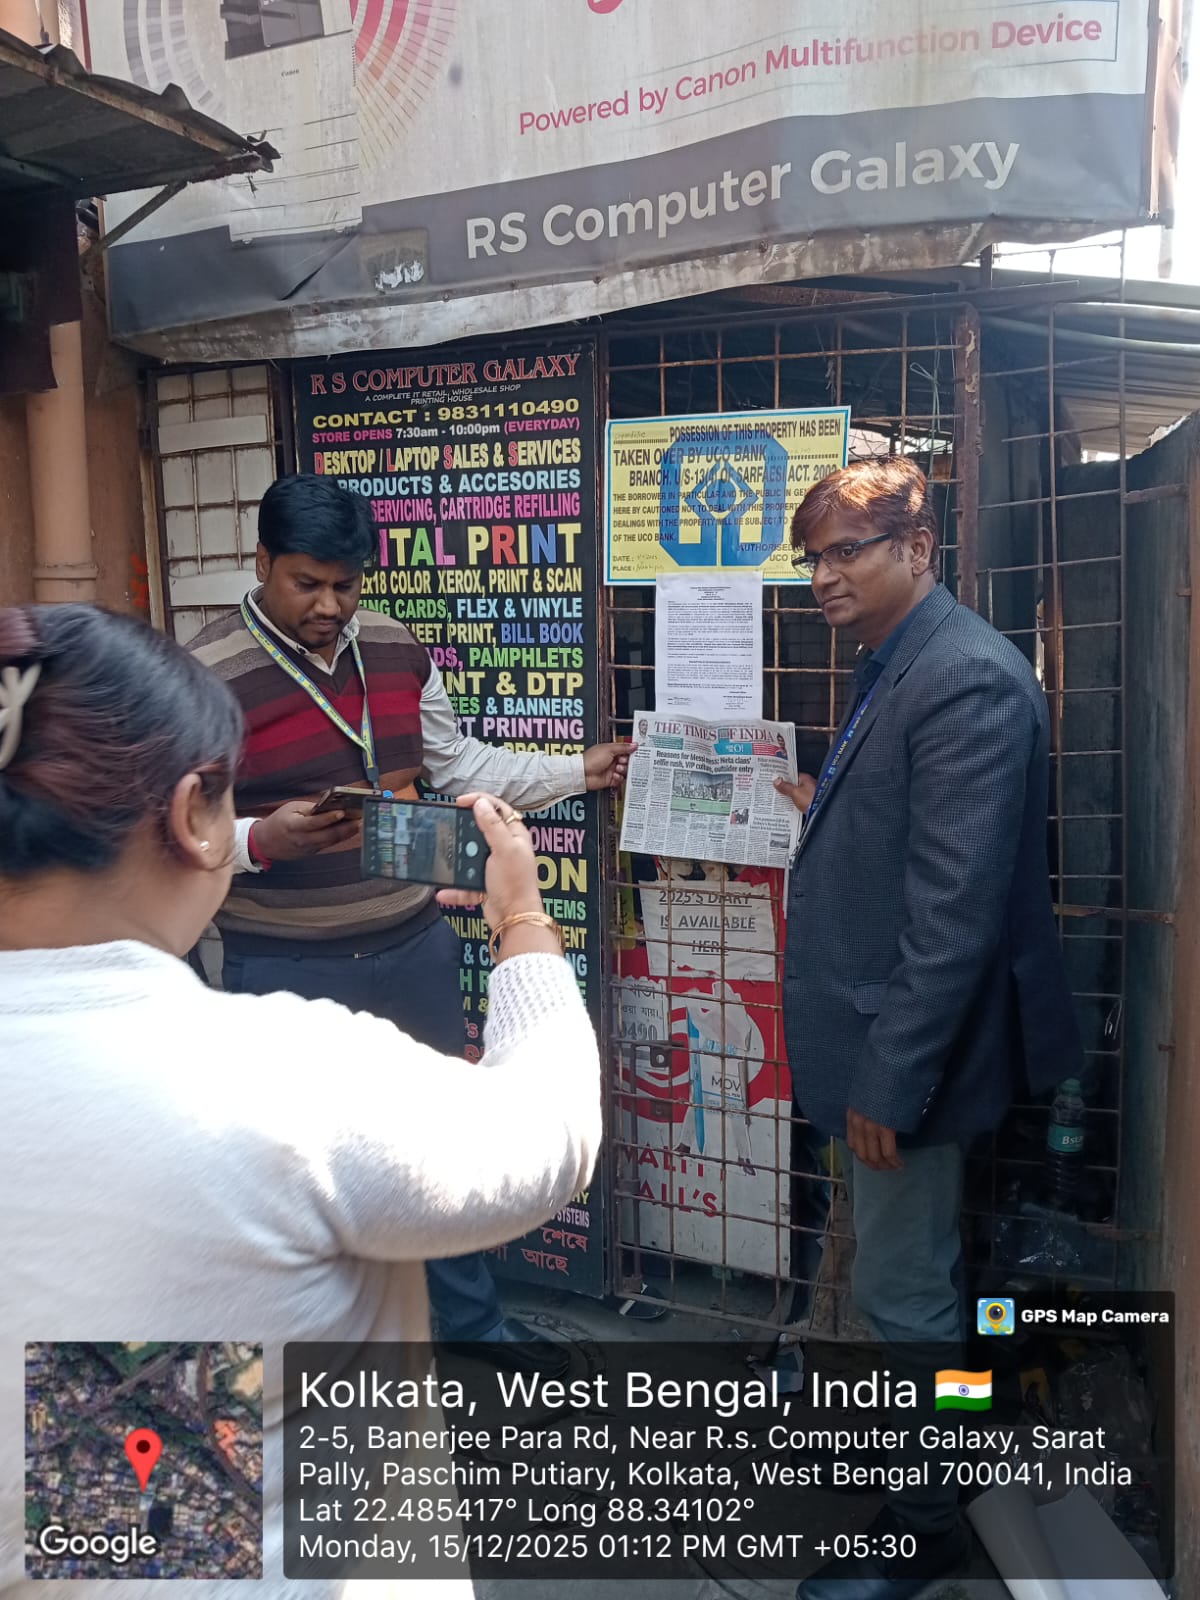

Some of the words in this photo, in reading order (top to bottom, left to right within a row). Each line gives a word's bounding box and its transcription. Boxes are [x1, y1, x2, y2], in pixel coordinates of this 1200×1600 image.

[518, 90, 629, 136] Powered
[638, 85, 669, 113] by
[675, 59, 758, 102] Canon
[764, 25, 980, 72] Multifunction
[990, 15, 1102, 50] Device
[465, 215, 528, 260] RS
[542, 158, 791, 247] Computer
[809, 141, 1019, 195] Galaxy
[311, 374, 327, 394] R
[332, 372, 347, 392] S
[352, 362, 477, 391] COMPUTER
[483, 353, 580, 382] GALAXY
[373, 393, 411, 401] COMPLETE
[452, 386, 497, 395] WHOLESALE
[499, 384, 521, 392] SHOP
[410, 397, 444, 405] PRINTING
[313, 409, 417, 428] CONTACT
[437, 398, 579, 421] 9831110490
[312, 431, 350, 443] STORE
[354, 428, 393, 441] OPENS
[396, 426, 438, 439] 7:30am
[449, 423, 500, 437] 10:00pm
[504, 417, 580, 434] (EVERYDAY)
[669, 425, 719, 443] POSSESSION
[721, 424, 733, 441] OF
[734, 423, 753, 440] THIS
[754, 420, 797, 439] PROPERTY
[799, 419, 816, 437] HAS
[818, 418, 841, 436] BEEN
[314, 450, 377, 475] DESKTOP
[386, 445, 439, 471] LAPTOP
[444, 443, 489, 469] SALES
[493, 442, 504, 467] &
[508, 437, 581, 467] SERVICES
[613, 449, 651, 466] TAKEN
[653, 447, 684, 465] OVER
[688, 446, 702, 464] BY
[705, 445, 731, 463] UCO
[734, 444, 767, 462] BANK
[438, 474, 452, 493] &
[459, 469, 581, 493] ACCESORIES
[629, 469, 672, 487] BRANCH.
[788, 464, 810, 482] ACT.
[440, 495, 511, 519] CARTRIDGE
[514, 492, 581, 518] REFILLING
[613, 493, 627, 501] THE
[628, 492, 666, 501] BORROWER
[755, 489, 781, 497] PUBLIC
[613, 519, 646, 528] DEALINGS
[379, 526, 456, 567] ITAL
[467, 522, 582, 566] PRINT
[613, 534, 622, 542] OF
[624, 534, 637, 542] THE
[638, 533, 653, 541] UCO
[769, 554, 789, 562] UCO
[360, 570, 387, 594] 2x18
[390, 570, 432, 594] COLOR
[438, 568, 486, 598] XEROX,
[489, 568, 528, 594] PRINT
[533, 568, 543, 592] &
[546, 567, 582, 592] SCAN
[394, 598, 452, 622] CARDS,
[457, 598, 499, 619] FLEX
[503, 598, 516, 618] &
[521, 597, 582, 618] VINYLE
[446, 623, 497, 648] PRINT,
[501, 623, 535, 644] BILL
[539, 622, 583, 644] BOOK
[469, 647, 584, 669] PAMPHLETS
[495, 671, 517, 695] &
[527, 672, 584, 696] DTP
[485, 697, 498, 715] &
[503, 697, 584, 717] BANNERS
[483, 717, 584, 740] PRINTING
[655, 721, 681, 735] THE
[683, 724, 717, 740] TIMES
[737, 728, 774, 742] INDIA
[530, 826, 585, 854] ONERY
[535, 855, 588, 893] ON
[543, 898, 587, 921] TEMS
[678, 915, 757, 929] AVAILABLE
[557, 1208, 590, 1228] SYSTEMS
